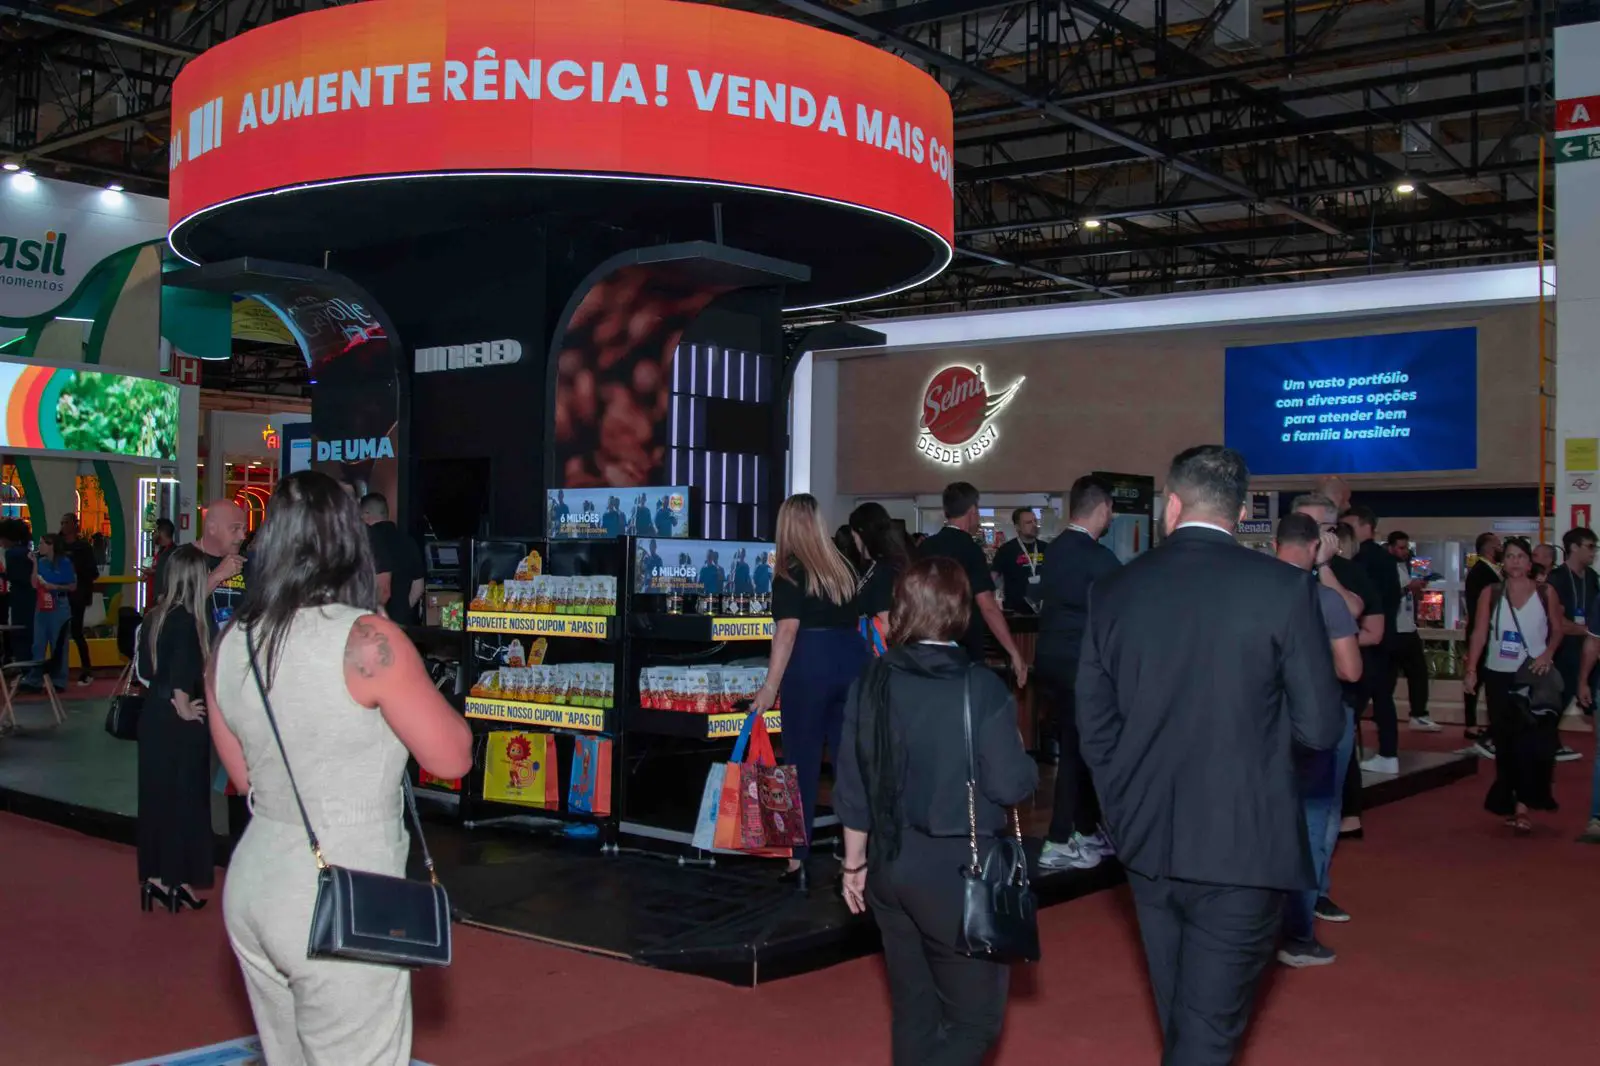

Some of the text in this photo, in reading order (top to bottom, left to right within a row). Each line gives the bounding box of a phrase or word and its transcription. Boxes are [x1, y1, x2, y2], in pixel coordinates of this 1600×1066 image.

[237, 62, 431, 133] AUMENTE
[444, 46, 668, 107] RÊNCIA!
[687, 69, 847, 137] VENDA
[856, 103, 924, 164] MAIS
[1571, 103, 1590, 123] A
[180, 361, 198, 383] H
[1282, 371, 1409, 390] Um vasto portfólio
[920, 365, 985, 428] Selmi
[1275, 389, 1417, 408] com diversas opções
[1284, 408, 1407, 427] para atender bem
[1282, 425, 1410, 442] a família brasileira
[317, 436, 395, 461] DE UMA
[916, 424, 998, 464] DESDE 1887
[566, 511, 600, 523] MILHÕES
[1238, 522, 1271, 533] Renata
[651, 564, 697, 577] 6 MILHÕES
[466, 615, 508, 629] APROVEITE
[509, 617, 535, 631] NOSSO
[537, 619, 565, 632] CUPOM
[712, 622, 761, 637] APROVEITE
[465, 702, 505, 717] APROVEITE
[507, 705, 533, 720] NOSSO
[534, 707, 563, 723] CUPOM
